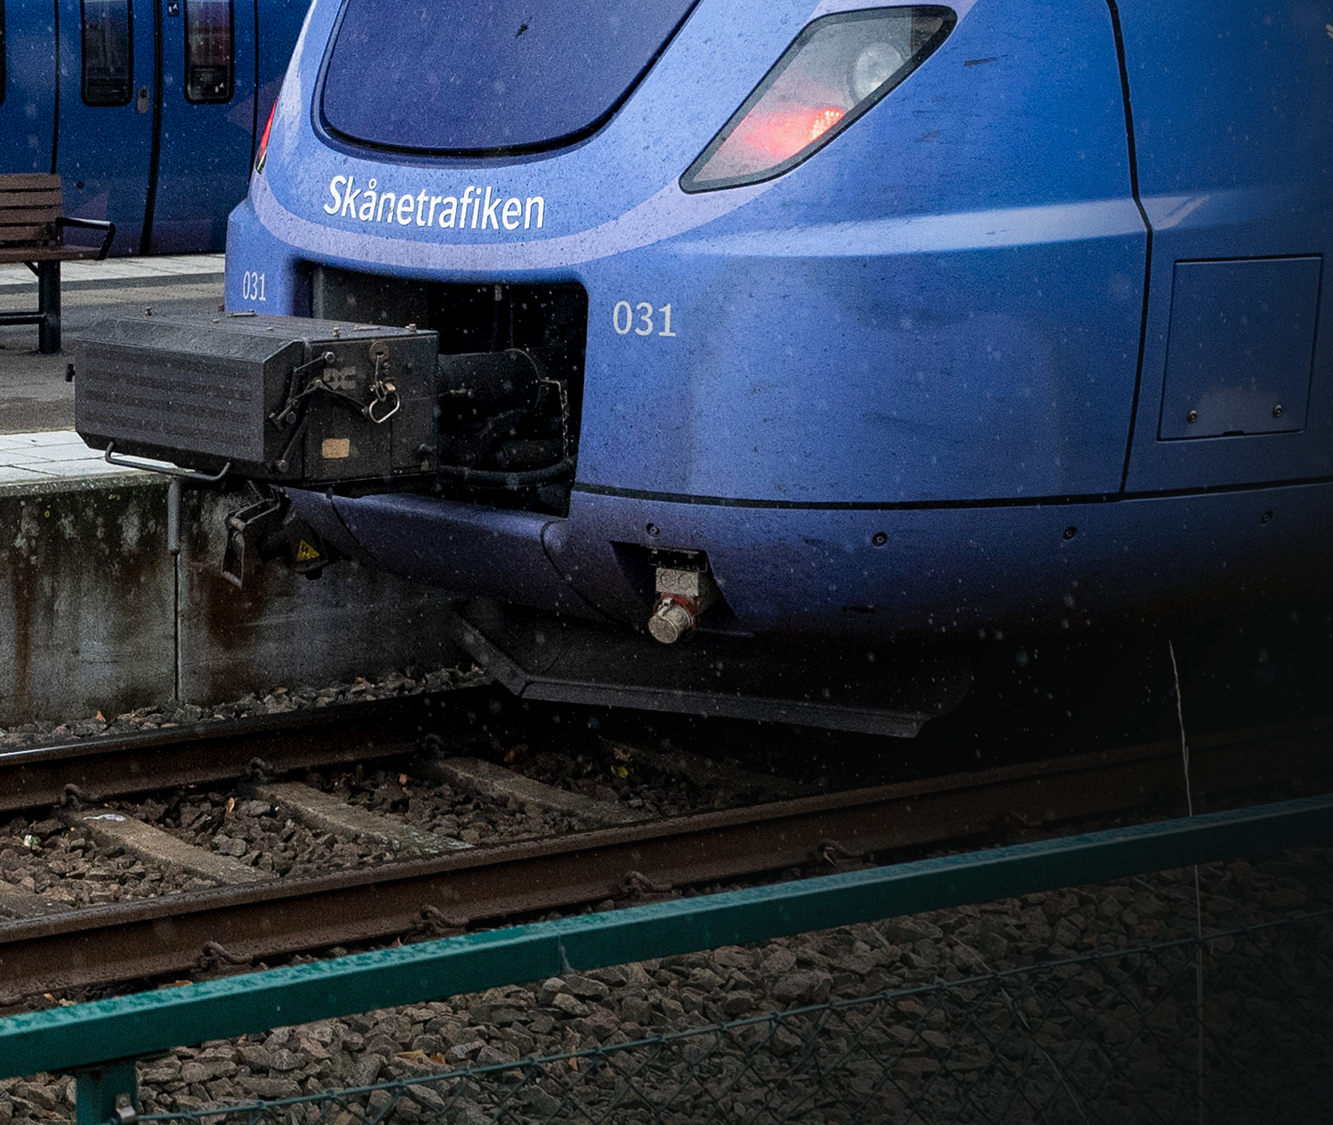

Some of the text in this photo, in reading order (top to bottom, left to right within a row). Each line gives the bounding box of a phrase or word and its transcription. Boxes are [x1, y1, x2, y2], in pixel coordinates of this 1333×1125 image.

[323, 175, 546, 230] Skånetrafiken
[241, 270, 267, 301] 031
[612, 300, 677, 337] 031
